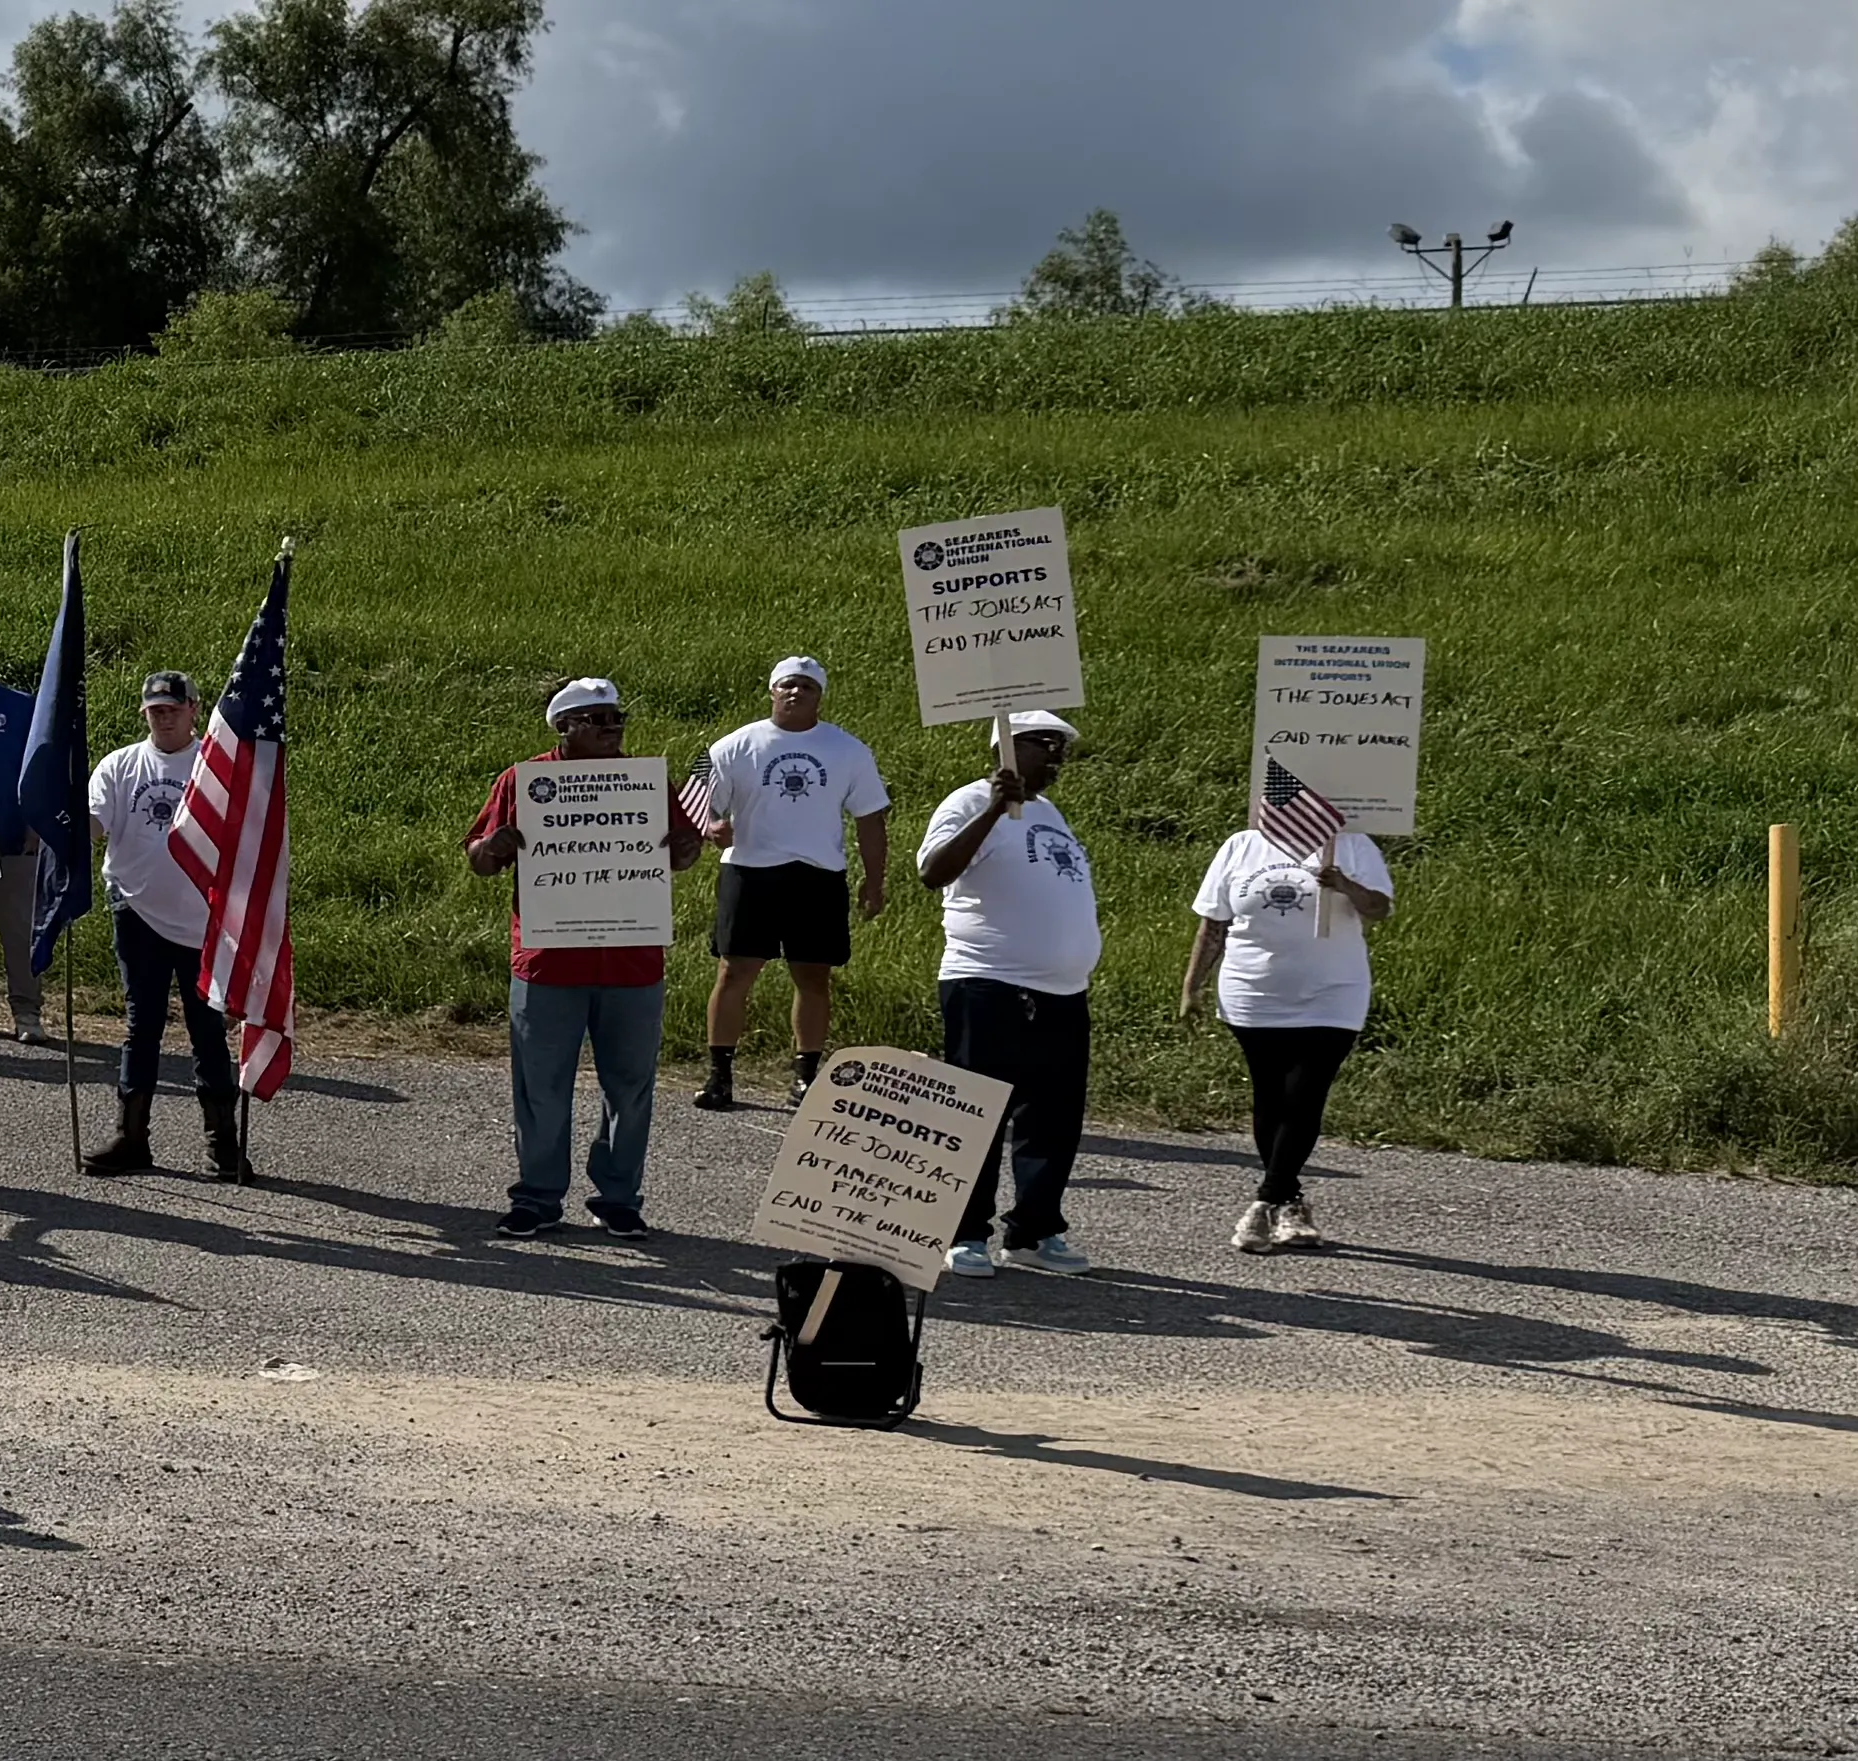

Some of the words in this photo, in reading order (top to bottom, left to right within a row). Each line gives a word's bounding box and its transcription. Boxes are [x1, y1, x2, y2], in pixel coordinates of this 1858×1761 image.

[944, 528, 1021, 548] SEAFARERS
[945, 535, 1052, 557] INTERNATIONAL
[947, 554, 990, 568] UNION
[932, 567, 1048, 595] SUPPORTS
[915, 601, 963, 624] THE
[968, 595, 1031, 618] JONES
[1033, 594, 1066, 612] ACT
[924, 635, 967, 655] END
[972, 628, 1006, 649] THE
[1295, 645, 1318, 653] THE
[1322, 645, 1391, 655] SEAFARERS
[1274, 658, 1368, 668] INTERNATIONAL
[1372, 659, 1411, 669] UNION
[1310, 672, 1372, 681] SUPPORTS
[1268, 687, 1314, 703] THE
[1317, 690, 1378, 706] JONES
[1381, 691, 1414, 709] ACT
[1268, 730, 1310, 745] END
[1316, 733, 1354, 746] THE
[558, 773, 629, 784] SEAFARERS
[558, 782, 656, 794] INTERNATIONAL
[558, 794, 599, 804] UNION
[543, 812, 649, 828] SUPPORTS
[531, 841, 611, 857] AMERICAN
[614, 840, 654, 855] JOBS
[534, 871, 577, 887] END
[582, 868, 615, 885] THE
[869, 1061, 957, 1096] SEAFARERS
[861, 1082, 912, 1106] UNION
[865, 1071, 985, 1119] INTERNATIONAL
[831, 1098, 963, 1152] SUPPORTS
[808, 1119, 860, 1147] THE
[860, 1135, 929, 1175] JONES
[927, 1169, 969, 1193] ACT
[796, 1151, 836, 1170] PUT
[834, 1163, 938, 1204] AMERICANS
[831, 1180, 900, 1208] FIRST
[771, 1190, 823, 1213] END
[831, 1205, 873, 1226] THE
[875, 1219, 944, 1254] WAIVER
